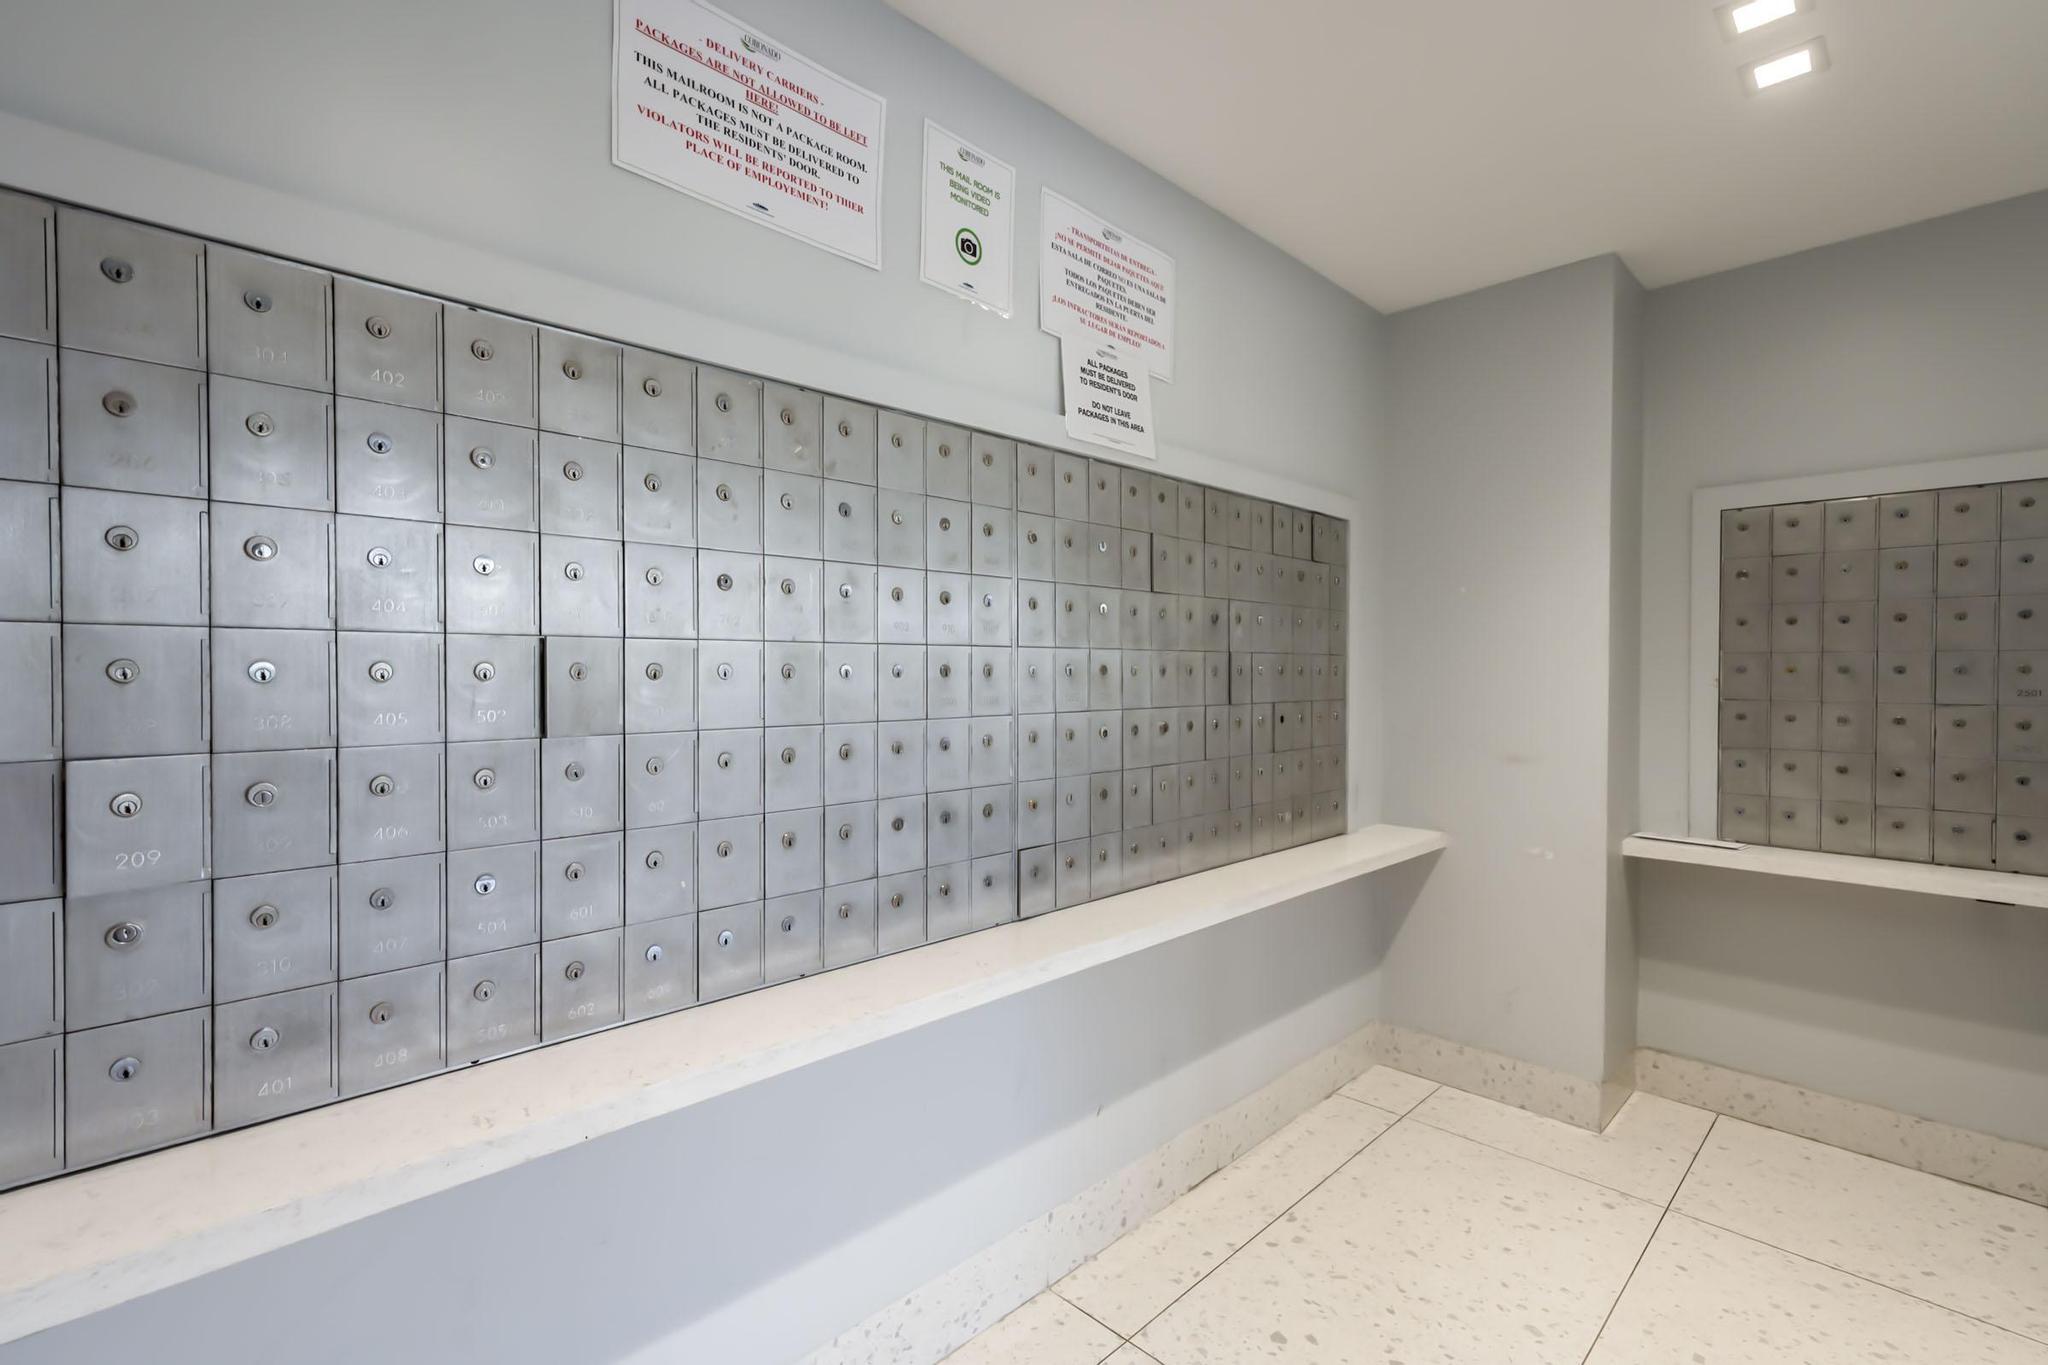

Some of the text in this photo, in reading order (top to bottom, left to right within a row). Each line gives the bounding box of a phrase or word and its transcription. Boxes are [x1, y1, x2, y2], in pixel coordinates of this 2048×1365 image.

[636, 18, 868, 146] PACKAGES ARE NOT ALLOWED TO BE LEFT
[706, 38, 763, 76] DELIVERY
[766, 70, 819, 105] CARRIERS
[635, 51, 868, 174] THIS MAILROOM IS NOT A PACKAGE ROOM.
[746, 89, 778, 113] HERE!
[644, 75, 860, 186] ALL PACKAGES MUST BE DELIVERED TO
[637, 104, 864, 215] VIOLATORS WILL BE REPORTED TO THIER
[697, 114, 720, 132] THE
[789, 157, 821, 179] DOOR.
[686, 140, 829, 211] PLACE OF EMPLOYEMENT!
[940, 161, 1001, 201] THIS MAIL ROOM IS
[949, 178, 990, 208] BEING VIDEO
[950, 191, 989, 218] MONITORED
[1072, 226, 1120, 258] TRANSPORTISTAS
[1121, 253, 1128, 262] DE
[1130, 258, 1155, 277] ENTREGA
[1076, 242, 1101, 261] PERMITE
[1103, 256, 1120, 271] DEJAR
[1122, 266, 1149, 286] PAQUETES
[1052, 241, 1067, 255] ESTA
[1068, 250, 1083, 263] SALA
[1084, 258, 1091, 267] DE
[1093, 262, 1117, 280] CORREO
[1127, 280, 1133, 288] ES
[1134, 283, 1145, 294] UNA
[1146, 289, 1159, 301] SALA
[1160, 296, 1166, 304] DE
[1065, 268, 1156, 317] TODOS LOS PAQUETES DEBEN SER
[1066, 278, 1154, 325] ENTREGADOS EN LA PUERTA DEL
[1067, 301, 1108, 325] INFRACTORES
[1127, 328, 1161, 348] REPORTADOS
[1088, 321, 1108, 335] LUGAR
[1109, 330, 1116, 338] DE
[370, 368, 407, 388] 402
[1080, 366, 1136, 392] MUST BE DELIVERED
[1087, 359, 1128, 379] ALL PACKAGES
[1080, 377, 1138, 402] TO RESIDENT'S DOOR
[1078, 407, 1144, 433] PACKAGES IN THIS AREA
[1092, 401, 1131, 420] DO NOT LEAVE
[370, 598, 407, 616] 404
[2015, 688, 2043, 698] 2501
[373, 711, 408, 729] 405
[114, 848, 162, 872] 209
[374, 1046, 409, 1069] 408
[257, 1076, 293, 1098] 401
